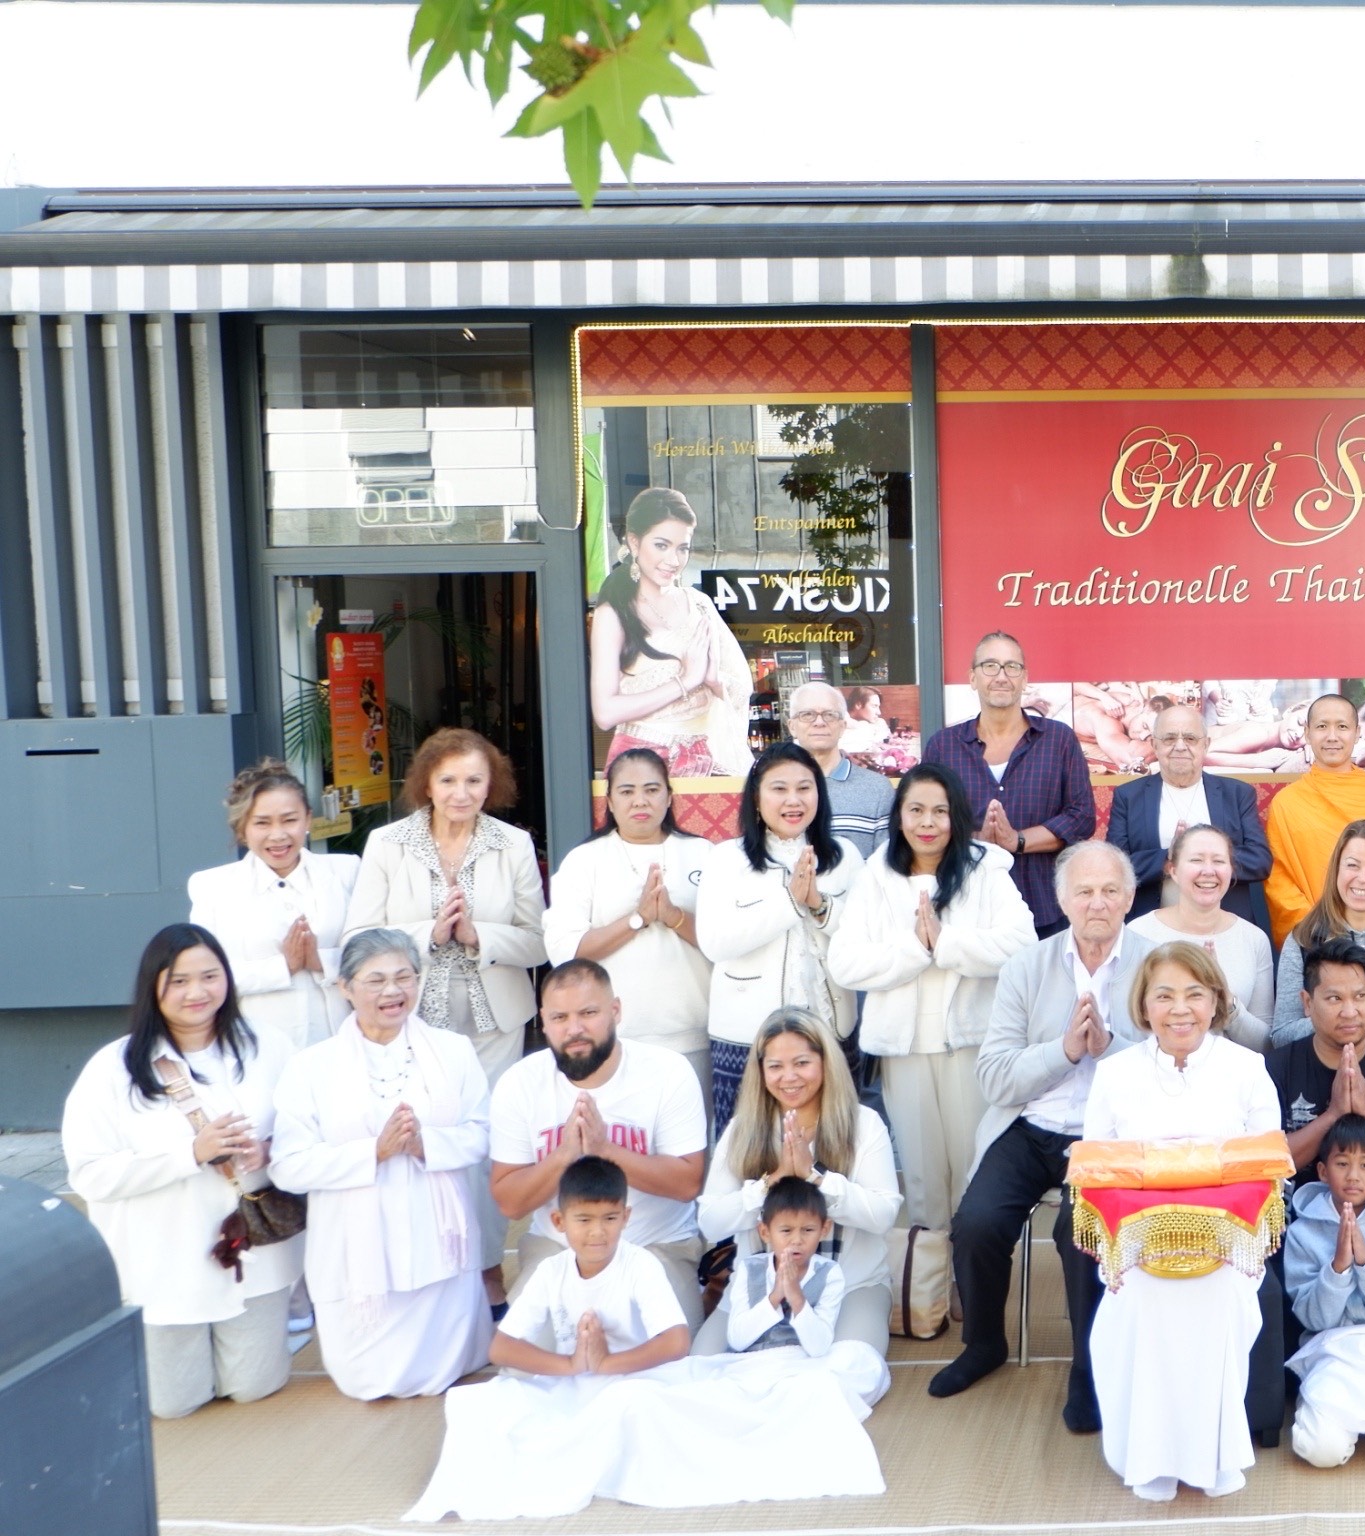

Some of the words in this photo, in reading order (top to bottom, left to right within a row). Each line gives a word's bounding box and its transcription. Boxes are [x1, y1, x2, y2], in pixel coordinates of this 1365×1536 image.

[653, 436, 725, 458] Herzlich
[1101, 425, 1281, 539] Gaai
[360, 488, 452, 522] OPEN
[753, 515, 857, 538] Entspannen
[760, 568, 857, 595] Wohlfühlen
[997, 565, 1250, 607] Traditionelle
[762, 623, 856, 644] Abschalten
